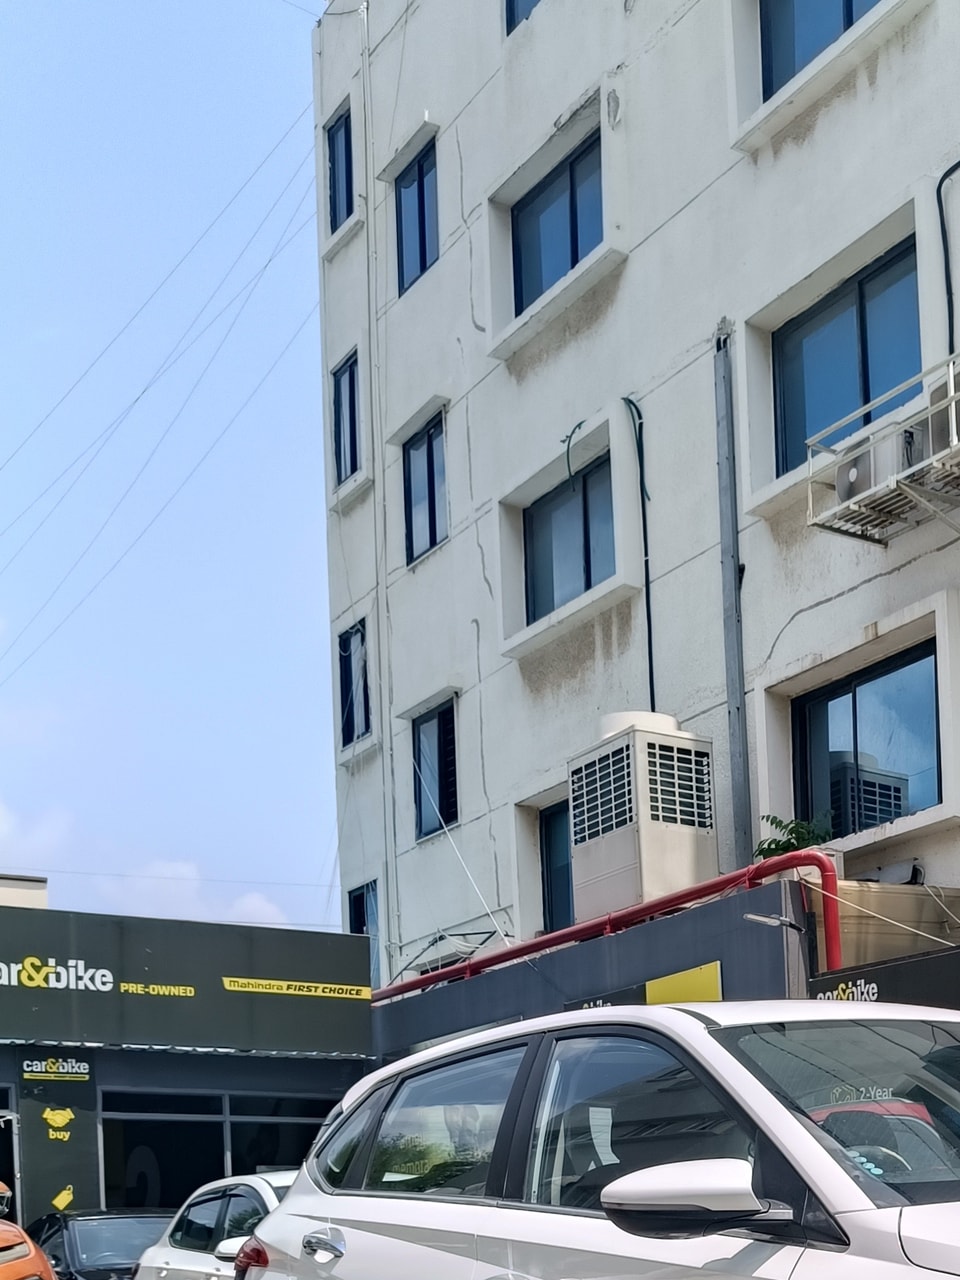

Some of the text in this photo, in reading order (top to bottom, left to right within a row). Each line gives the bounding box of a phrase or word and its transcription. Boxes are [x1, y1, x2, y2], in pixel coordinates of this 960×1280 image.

[0, 956, 195, 997] ar&bike PRE-OWNED
[228, 979, 363, 996] Mahindra FIRST CHOICE
[23, 1058, 89, 1073] car&bike
[48, 1128, 71, 1141] buy
